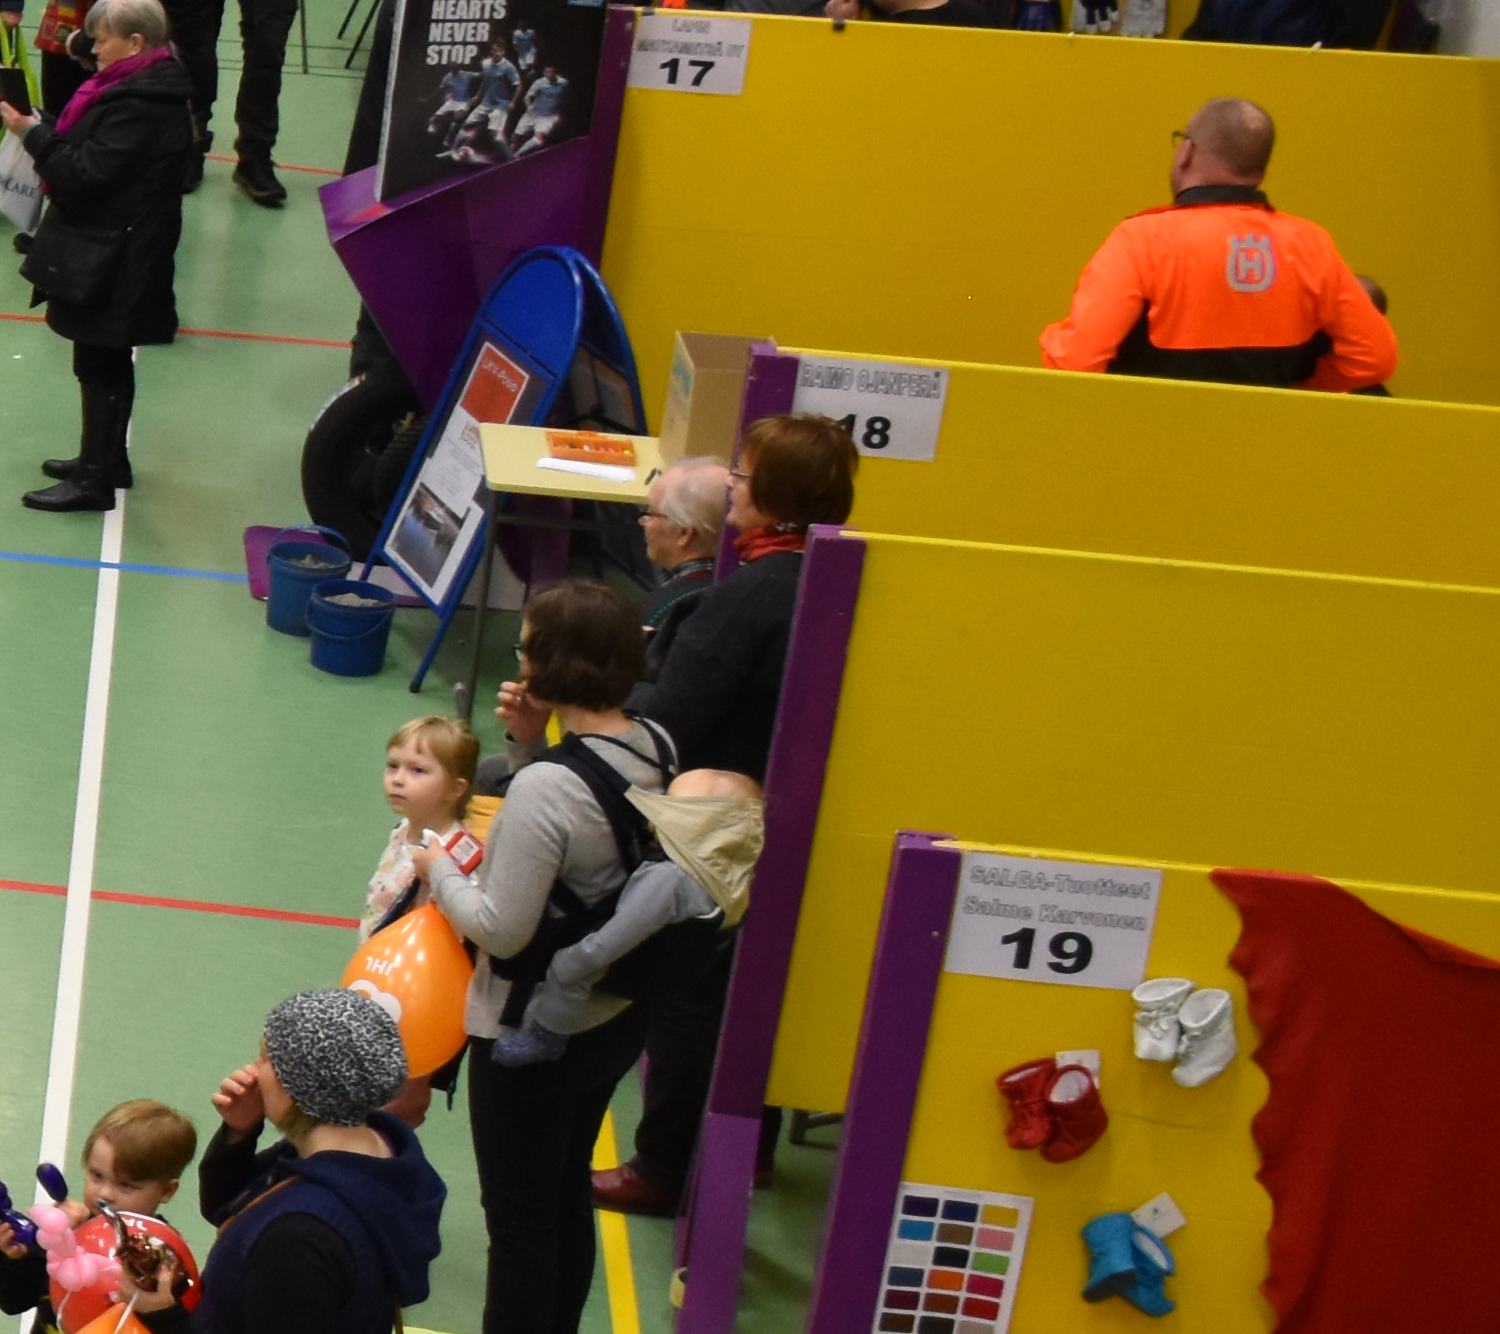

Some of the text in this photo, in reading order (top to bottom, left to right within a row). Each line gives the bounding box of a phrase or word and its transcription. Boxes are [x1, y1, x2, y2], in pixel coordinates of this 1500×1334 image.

[428, 22, 491, 43] NEVER
[426, 44, 478, 66] STOP
[659, 57, 716, 87] 17
[801, 364, 941, 399] RAIMO OJANPERÄ
[970, 864, 1150, 900] SALGA-Tuotteet
[963, 895, 1147, 931] Salme Karvonen
[1000, 927, 1093, 975] 19
